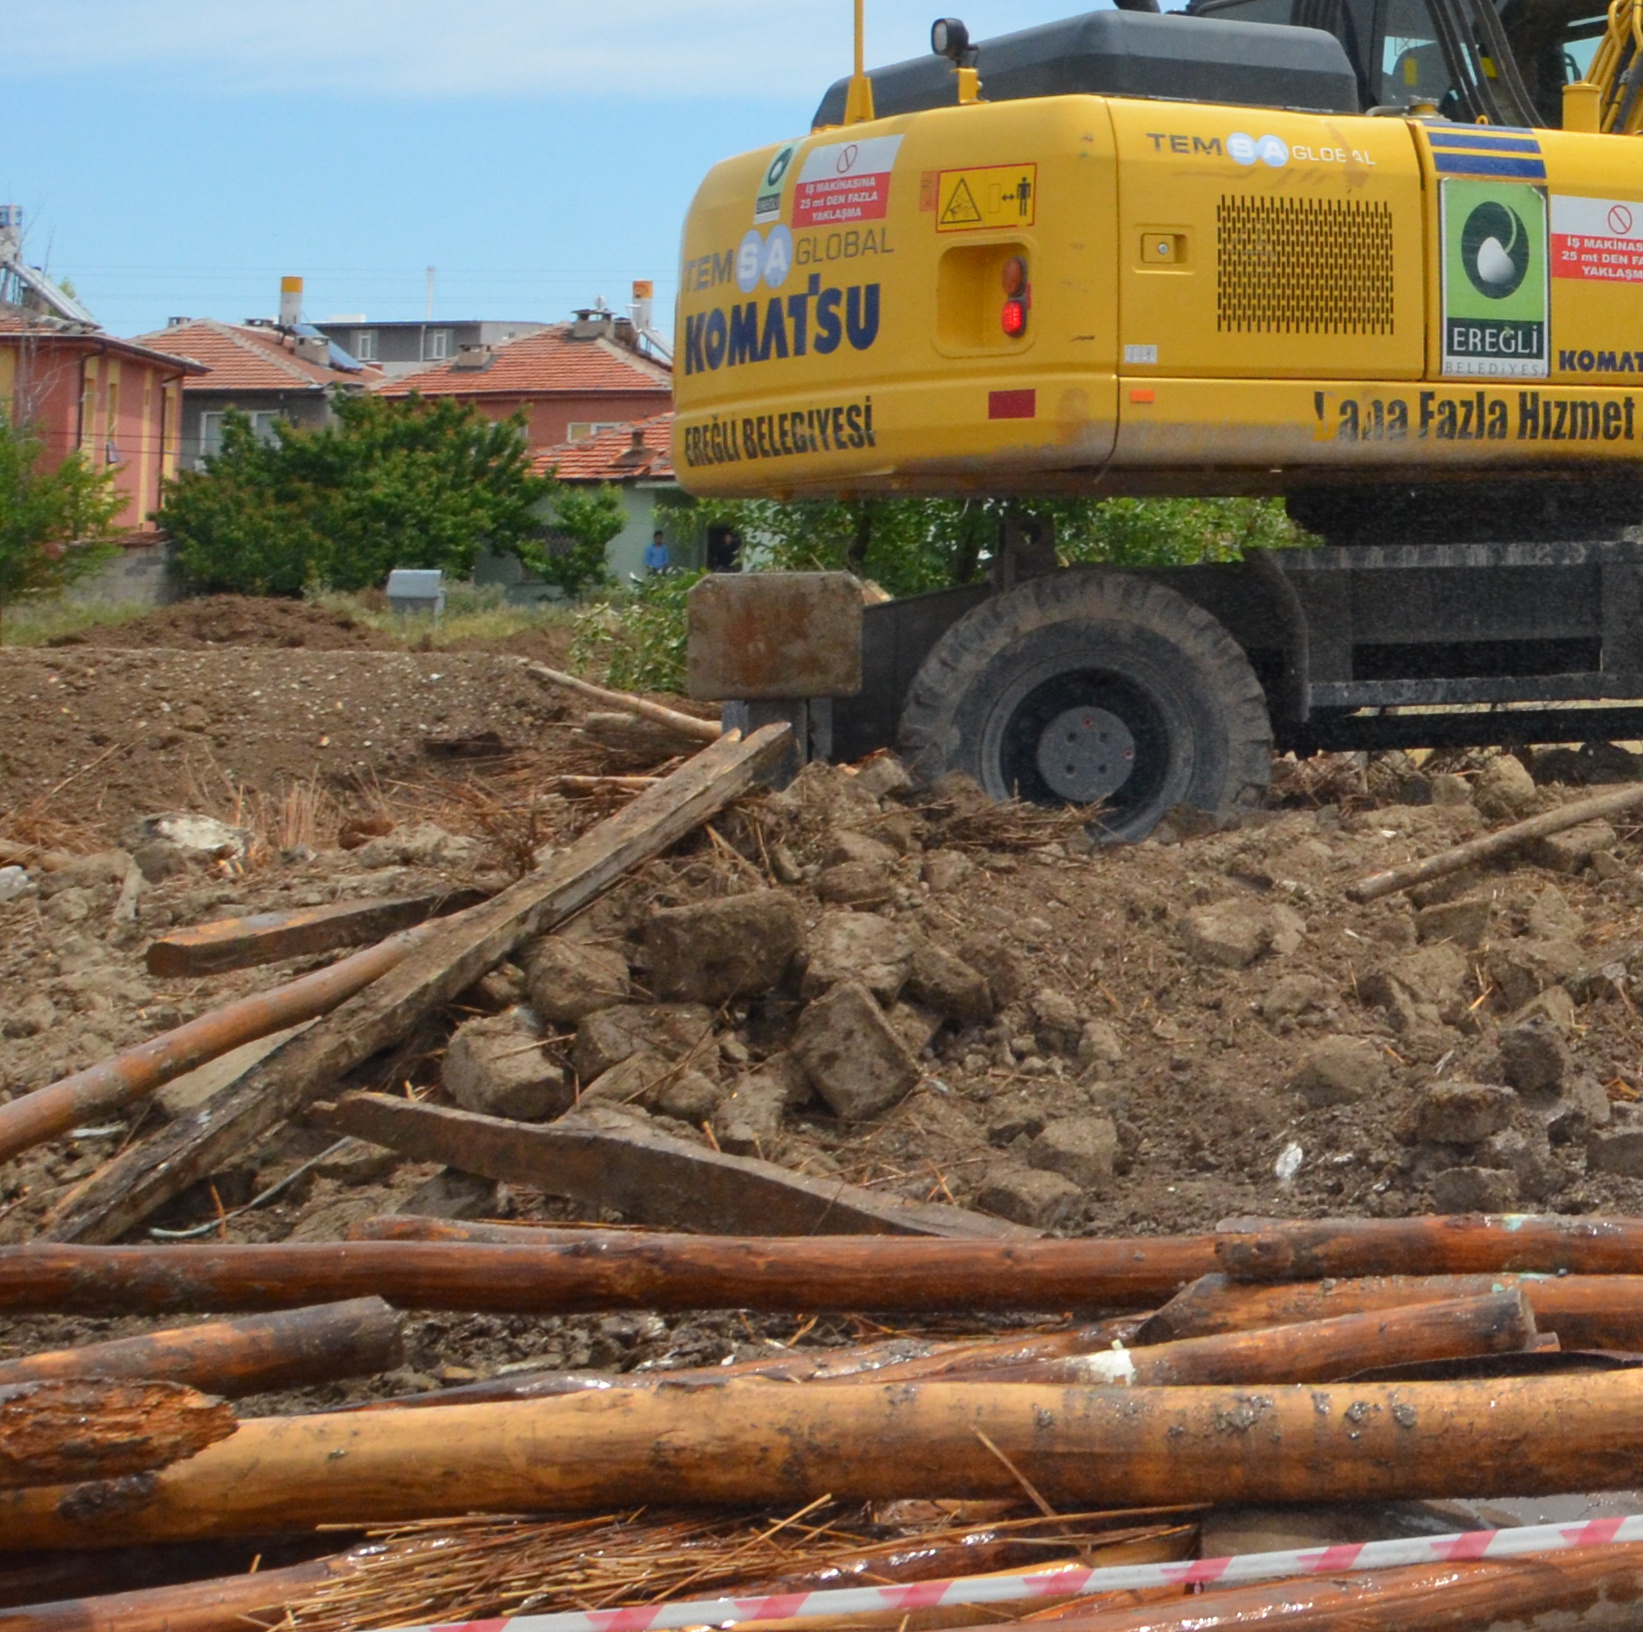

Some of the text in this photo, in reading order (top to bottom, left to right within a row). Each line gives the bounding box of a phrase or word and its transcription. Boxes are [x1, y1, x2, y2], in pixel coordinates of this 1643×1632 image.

[1146, 133, 1287, 164] TEMSA
[826, 194, 846, 206] DEN
[847, 190, 878, 203] FAZLA
[1567, 235, 1580, 248] İŞ
[684, 227, 894, 292] TEMSA GLOBAL
[1562, 250, 1577, 261] 25
[1581, 253, 1598, 262] mt
[1602, 254, 1628, 265] DEN
[684, 273, 880, 375] KOMATSU
[1418, 391, 1508, 441] Fazla
